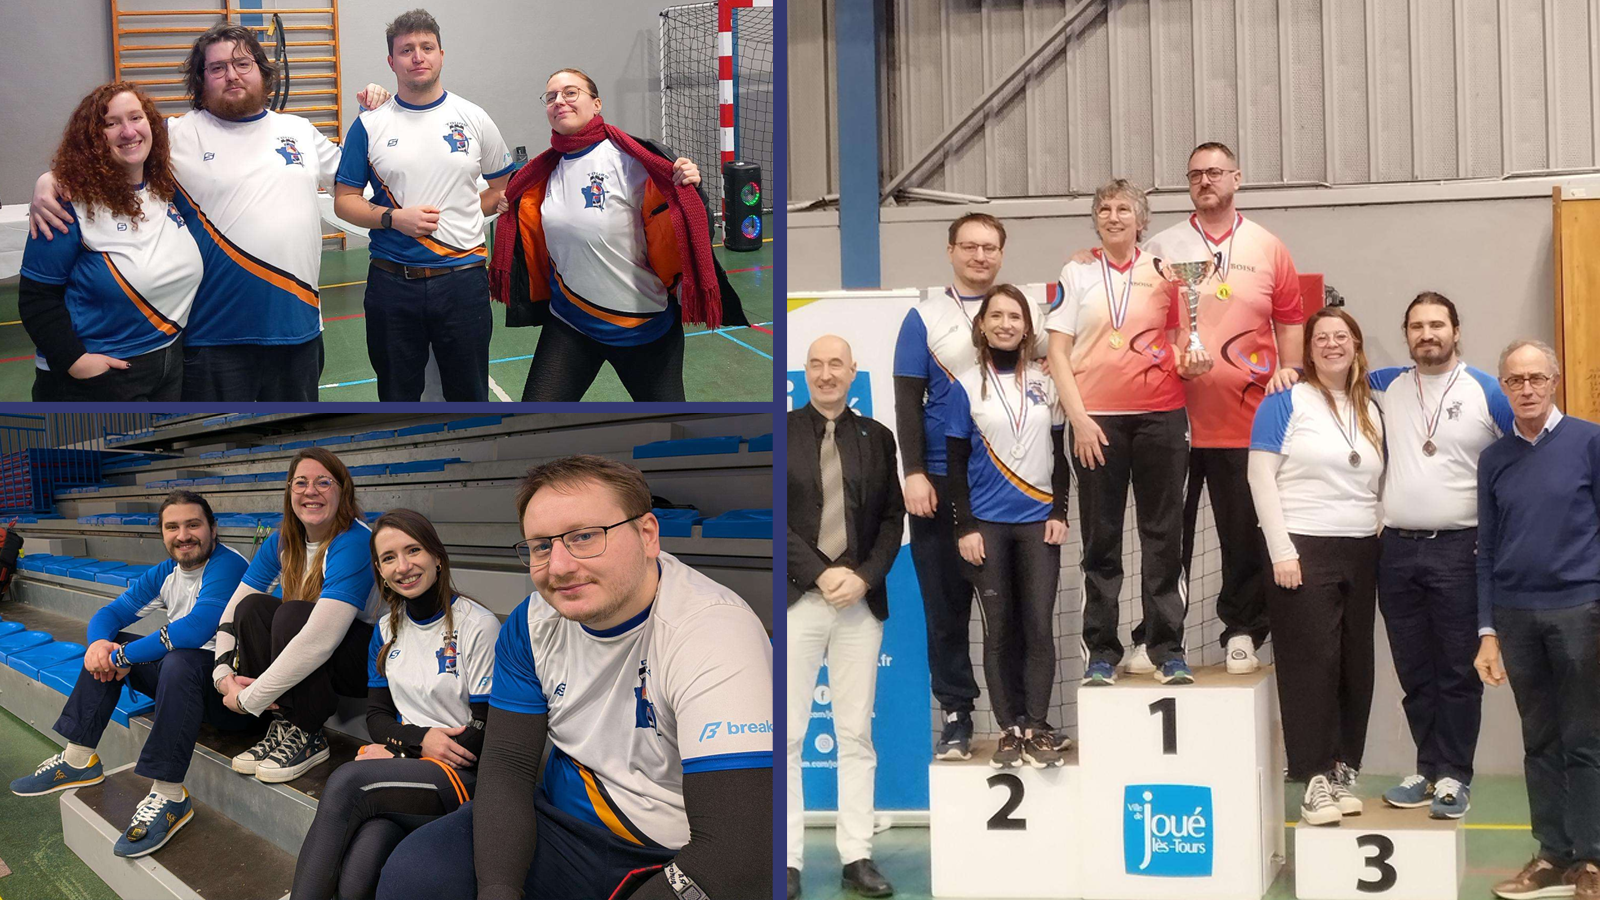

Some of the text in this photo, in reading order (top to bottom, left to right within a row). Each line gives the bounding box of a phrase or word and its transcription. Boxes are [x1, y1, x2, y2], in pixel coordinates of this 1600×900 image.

[1148, 697, 1178, 755] 1
[986, 773, 1027, 830] 2
[1152, 837, 1206, 854] lès-Tours
[1355, 834, 1398, 893] 3
